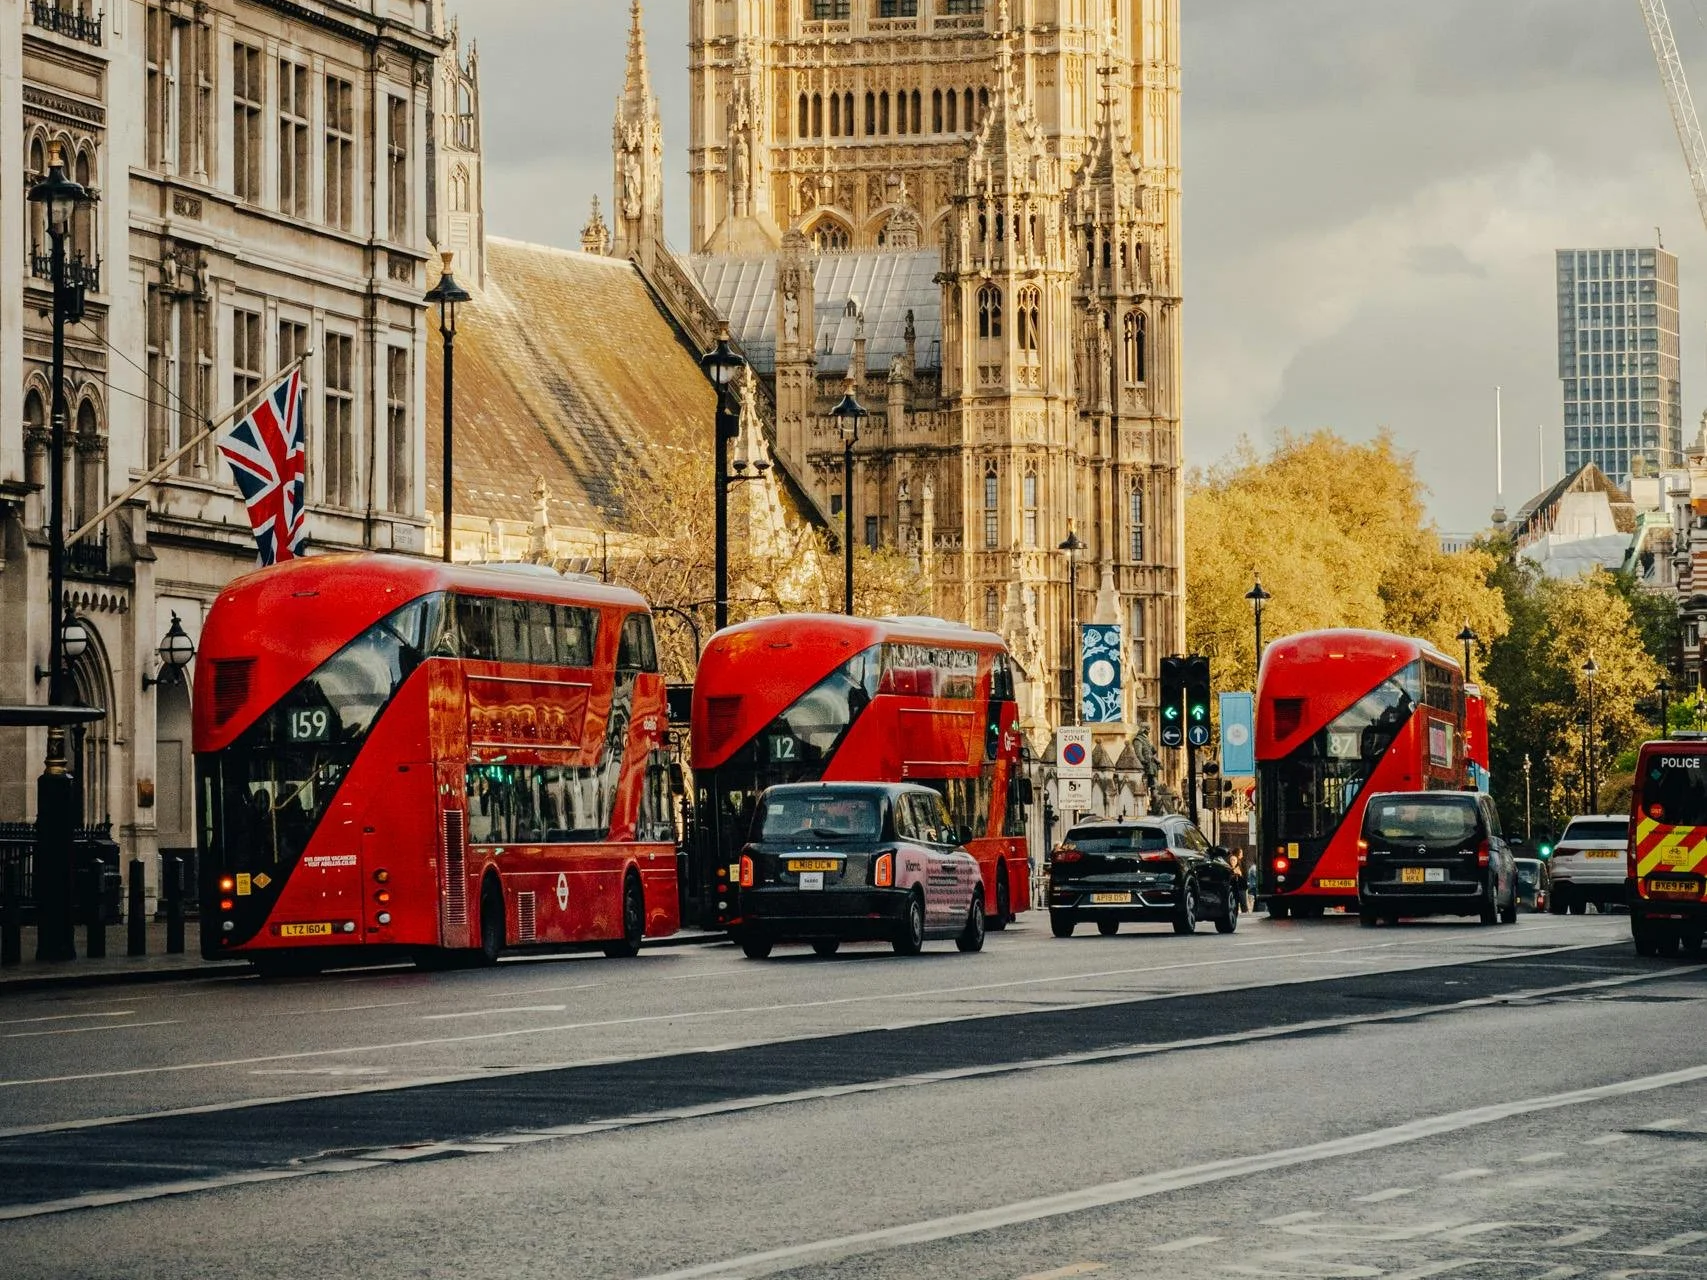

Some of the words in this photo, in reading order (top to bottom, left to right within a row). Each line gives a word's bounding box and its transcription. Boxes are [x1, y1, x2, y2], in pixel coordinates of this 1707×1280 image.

[292, 710, 327, 738] 159
[776, 737, 795, 758] 12
[1330, 734, 1353, 757] 87
[1661, 757, 1700, 768] POLICE
